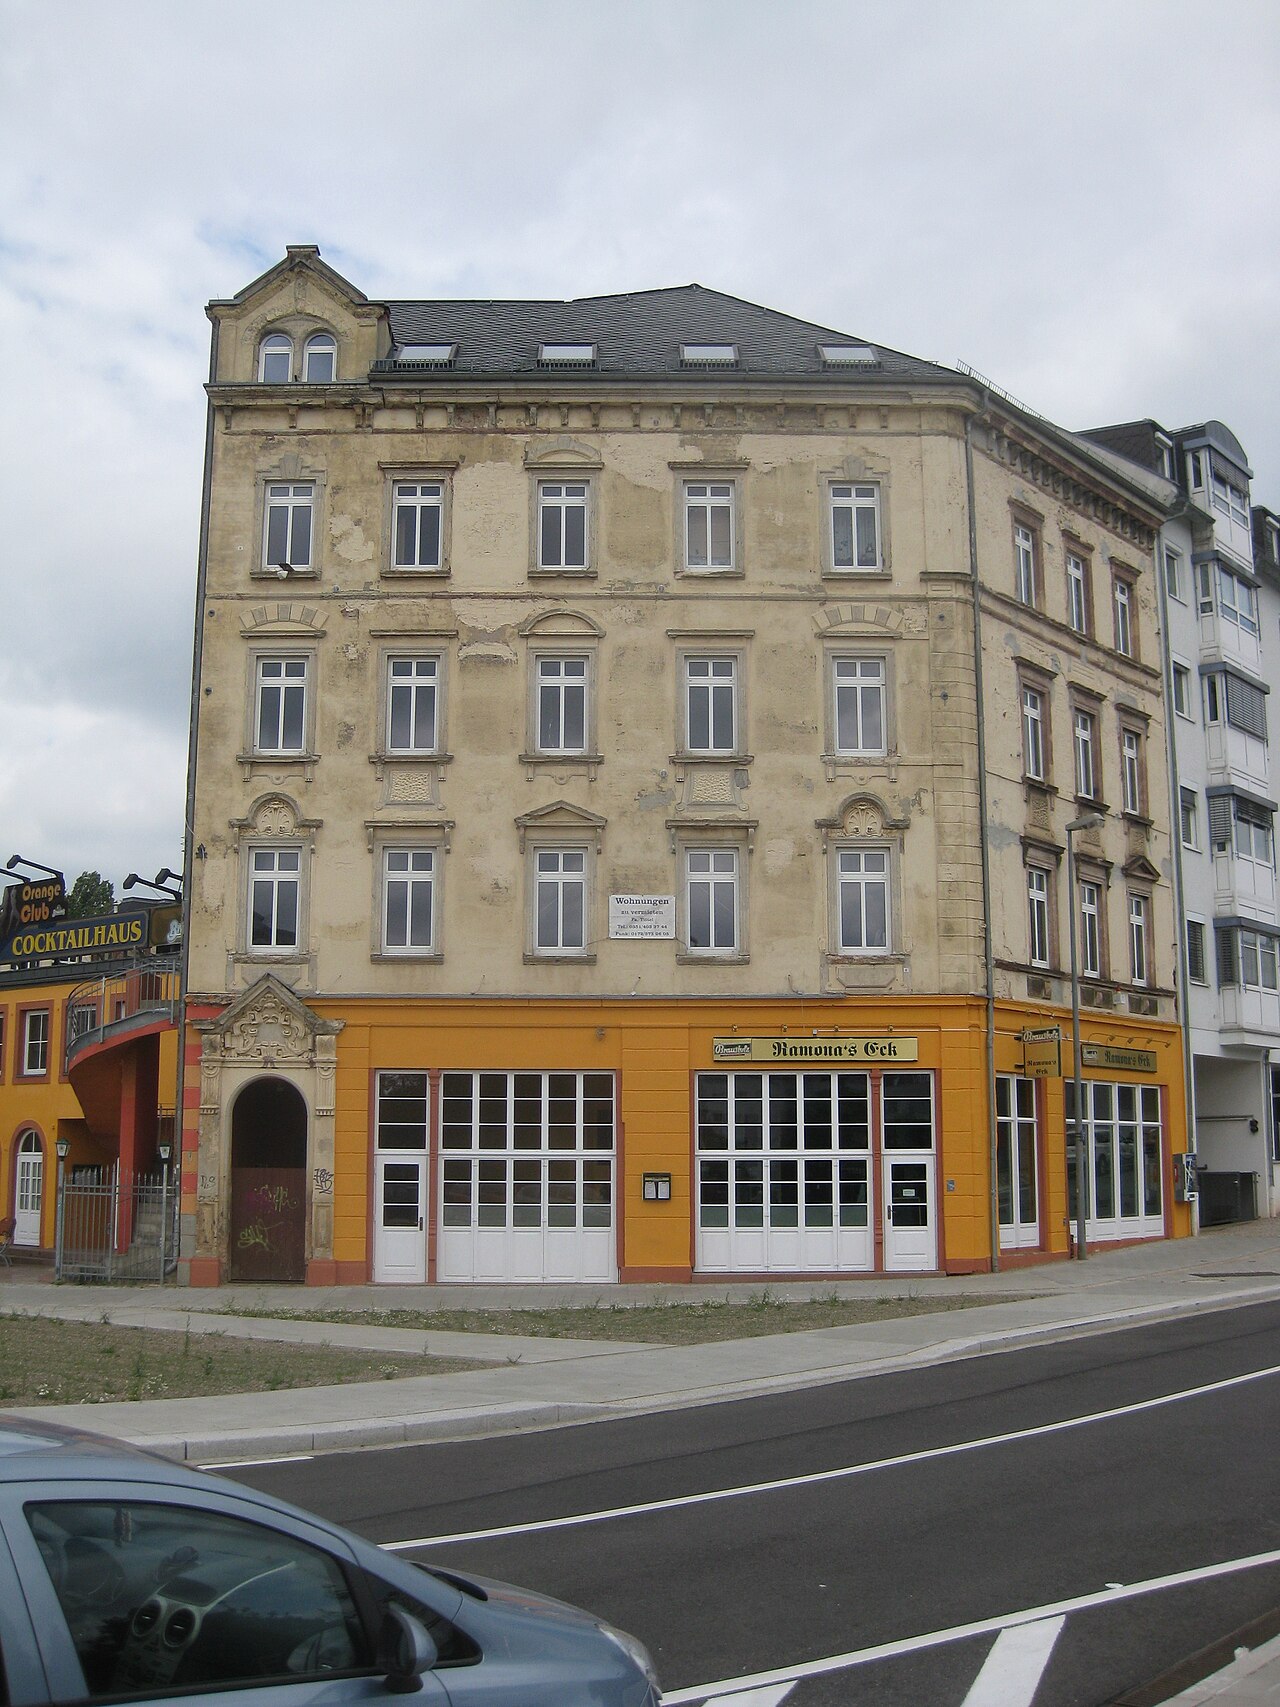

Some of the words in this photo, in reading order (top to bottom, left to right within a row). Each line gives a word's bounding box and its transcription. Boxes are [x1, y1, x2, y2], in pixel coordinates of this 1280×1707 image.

[22, 884, 61, 901] Orange
[615, 897, 669, 906] Wohnungen
[20, 902, 50, 923] Club
[11, 920, 143, 956] COCKTAILHAUS
[772, 1041, 858, 1057] Ramona's
[863, 1041, 898, 1057] Eck
